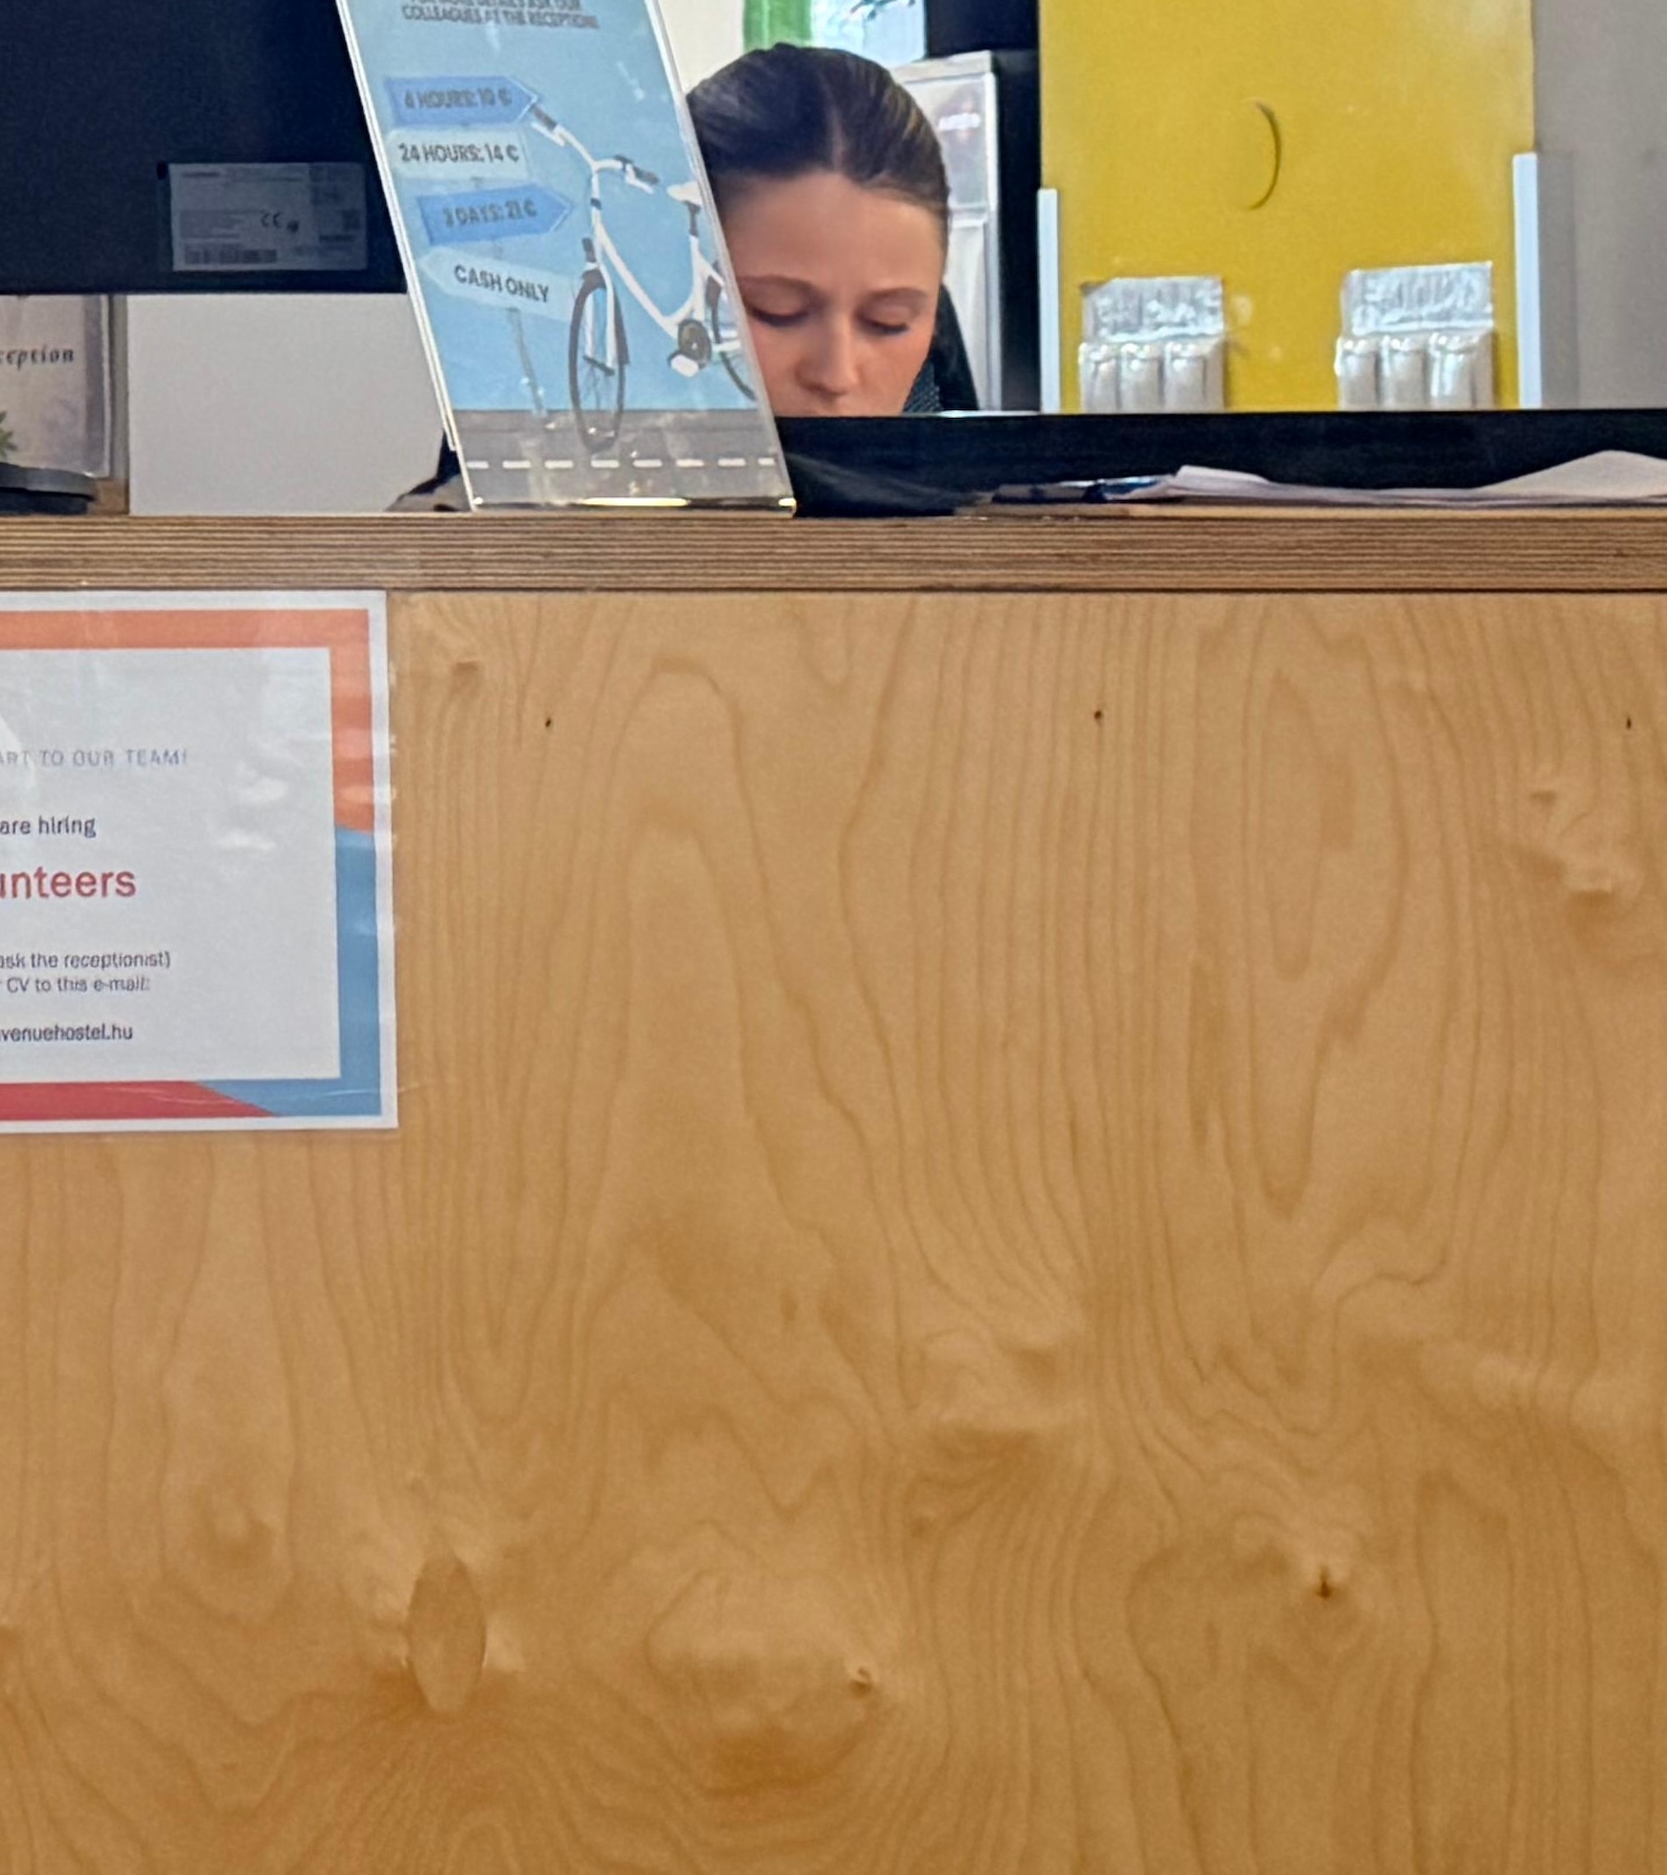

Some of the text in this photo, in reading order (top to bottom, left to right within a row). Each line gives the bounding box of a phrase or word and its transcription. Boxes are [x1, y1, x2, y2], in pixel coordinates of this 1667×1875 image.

[398, 142, 421, 163] 24
[425, 143, 485, 163] HOURS:
[486, 143, 504, 163] 14
[453, 263, 550, 303] CASH ONLY
[39, 750, 64, 767] TO
[72, 749, 115, 767] OUR
[126, 748, 189, 767] TEAM!
[39, 816, 97, 839] hiring
[31, 951, 59, 969] the
[64, 949, 171, 971] receptionist)
[6, 977, 31, 994] CV
[35, 977, 52, 993] to
[57, 976, 88, 993] this
